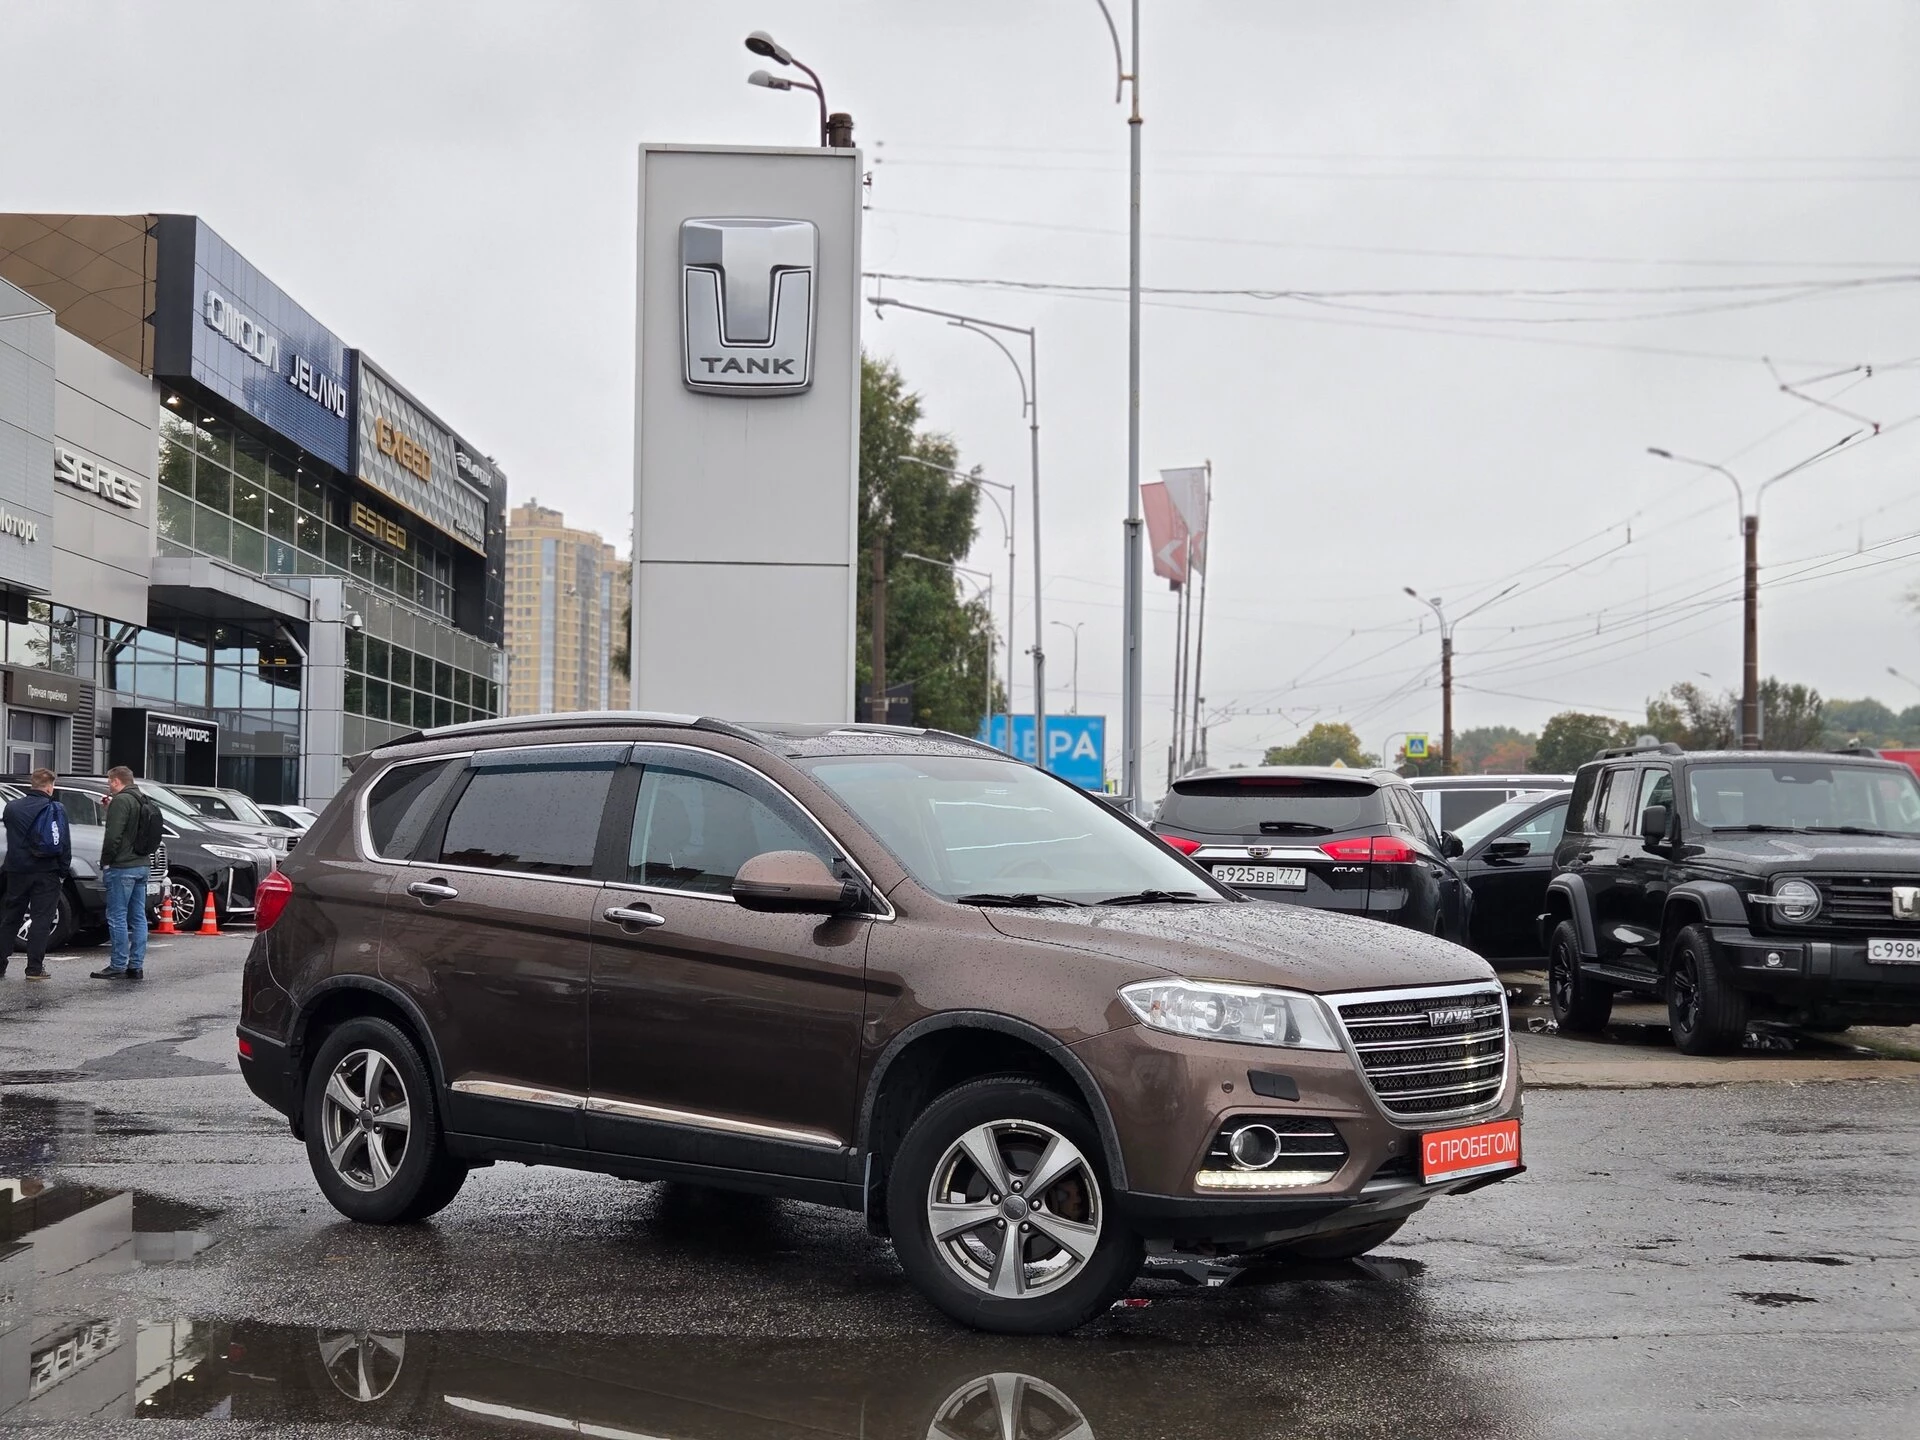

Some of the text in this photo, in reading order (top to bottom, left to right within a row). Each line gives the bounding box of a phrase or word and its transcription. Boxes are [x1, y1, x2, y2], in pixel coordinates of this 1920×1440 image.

[205, 290, 280, 373] OMODA
[289, 354, 346, 418] JELAND
[700, 357, 795, 375] TANK
[376, 417, 432, 482] EXEED
[54, 447, 142, 510] SERES
[156, 723, 210, 743] АЛАРМ-МОТОРС
[1434, 1010, 1473, 1025] HAVAL
[1427, 1131, 1516, 1165] С ПРОБЕГОМ
